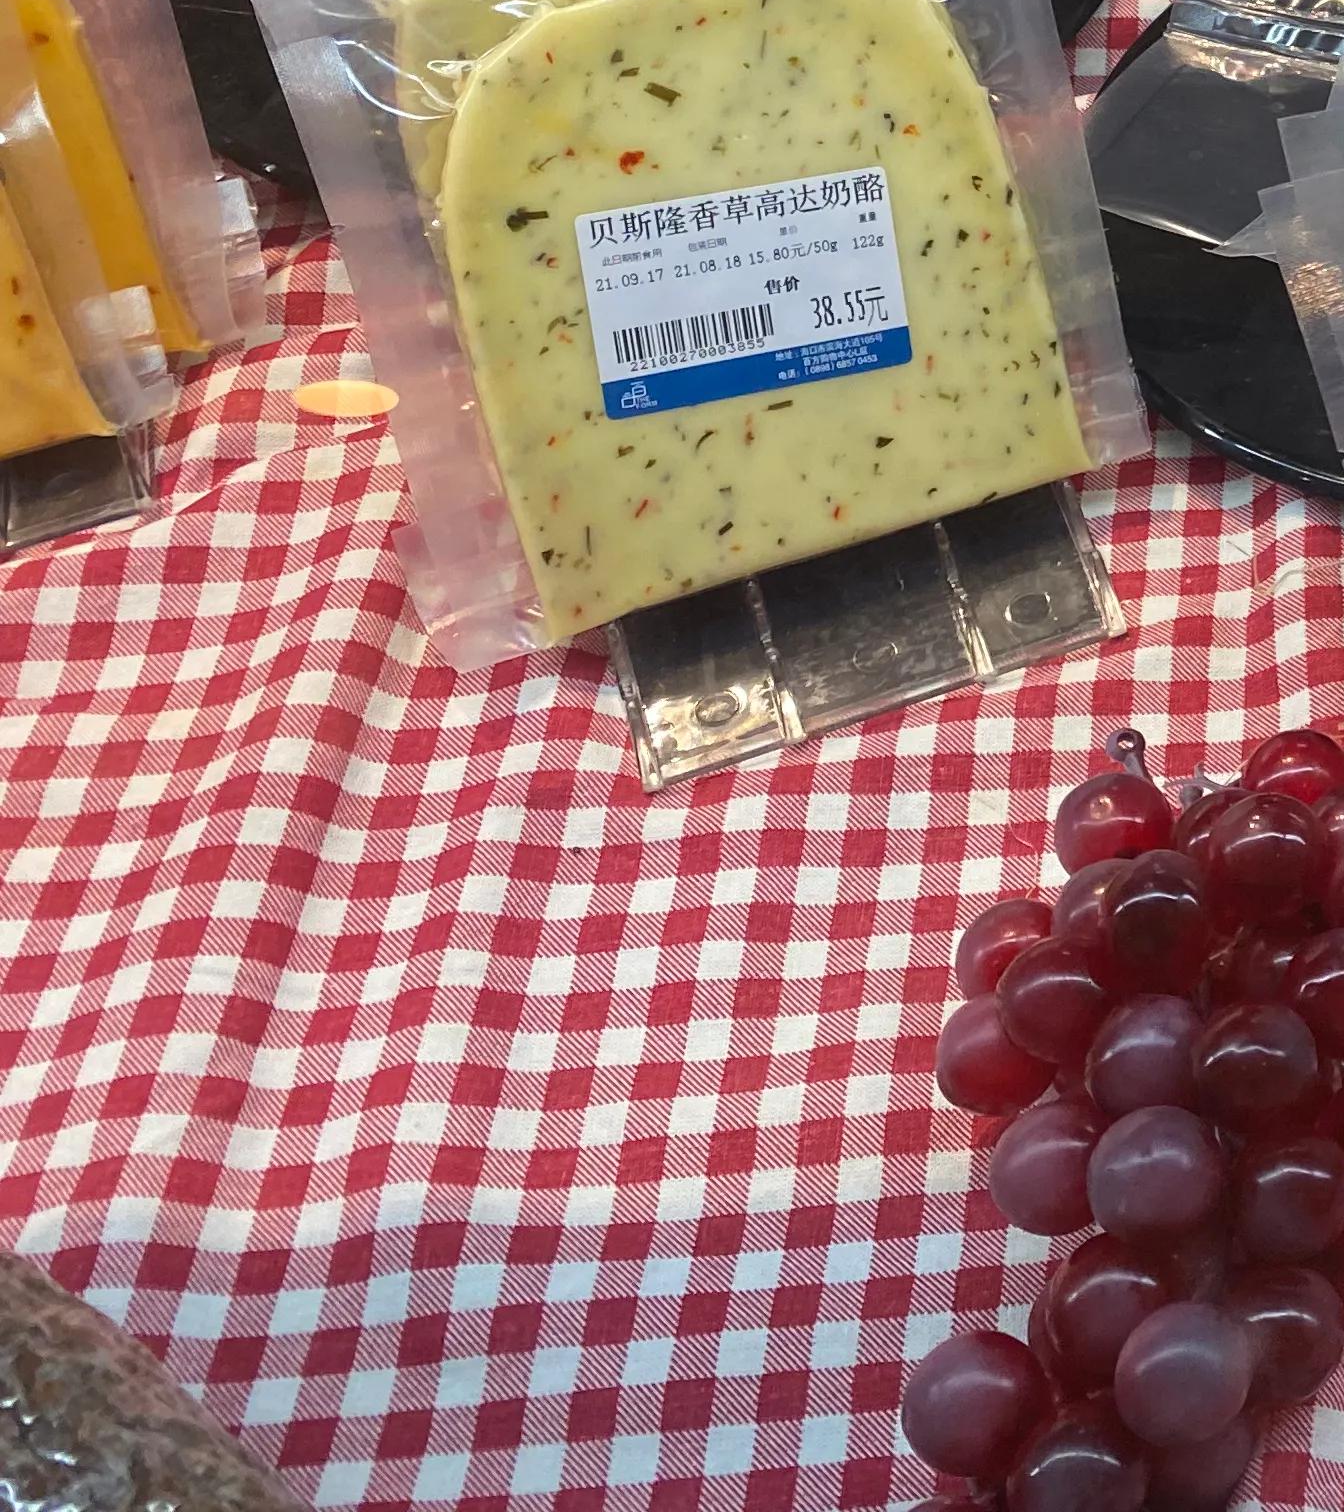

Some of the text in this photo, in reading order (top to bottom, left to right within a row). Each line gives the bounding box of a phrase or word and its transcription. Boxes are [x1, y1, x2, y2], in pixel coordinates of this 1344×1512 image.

[589, 173, 885, 249] 贝斯隆香草高达奶酪
[595, 234, 885, 292] 21.09.17 21.08.18 15.80元/50g 122g
[763, 275, 800, 295] 售价
[810, 286, 888, 329] 38.55元
[630, 337, 766, 372] 22100270003855
